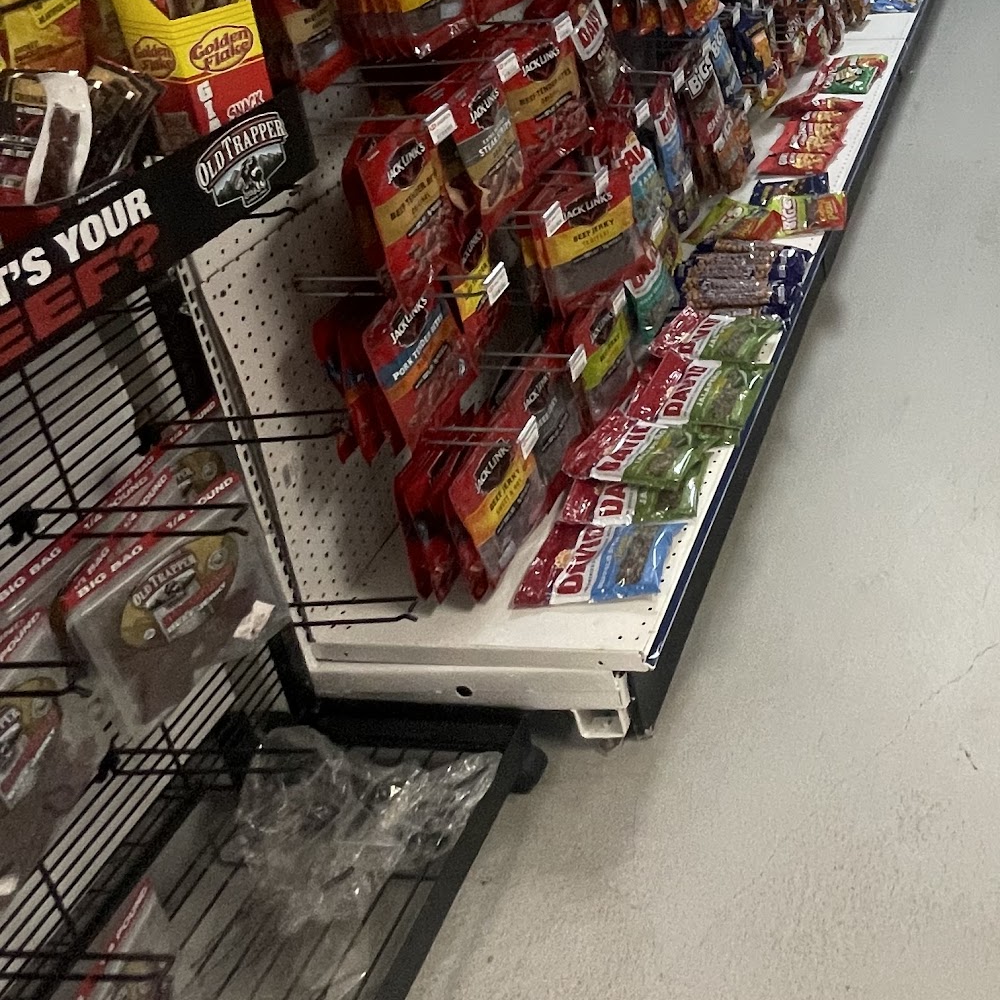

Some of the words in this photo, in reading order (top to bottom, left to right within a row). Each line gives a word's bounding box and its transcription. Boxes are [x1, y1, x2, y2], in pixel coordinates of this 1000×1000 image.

[192, 29, 248, 60] Golden
[203, 41, 249, 71] Flake
[522, 58, 541, 77] JACK
[687, 53, 714, 99] BIGS
[227, 89, 265, 121] SNACK
[198, 155, 228, 189] OLD
[221, 119, 288, 162] TRAPPER
[387, 162, 405, 185] JACK
[0, 246, 52, 306] T'S
[53, 187, 153, 264] YOUR
[573, 229, 592, 243] BEEF
[0, 223, 160, 368] EEF?
[390, 319, 409, 345] JACK
[392, 357, 414, 382] PORK
[0, 576, 27, 601] BIG
[29, 546, 62, 576] BAG
[83, 512, 103, 530] 1/4
[77, 572, 107, 599] BIG
[110, 543, 143, 573] BAG
[165, 510, 187, 530] 1/4
